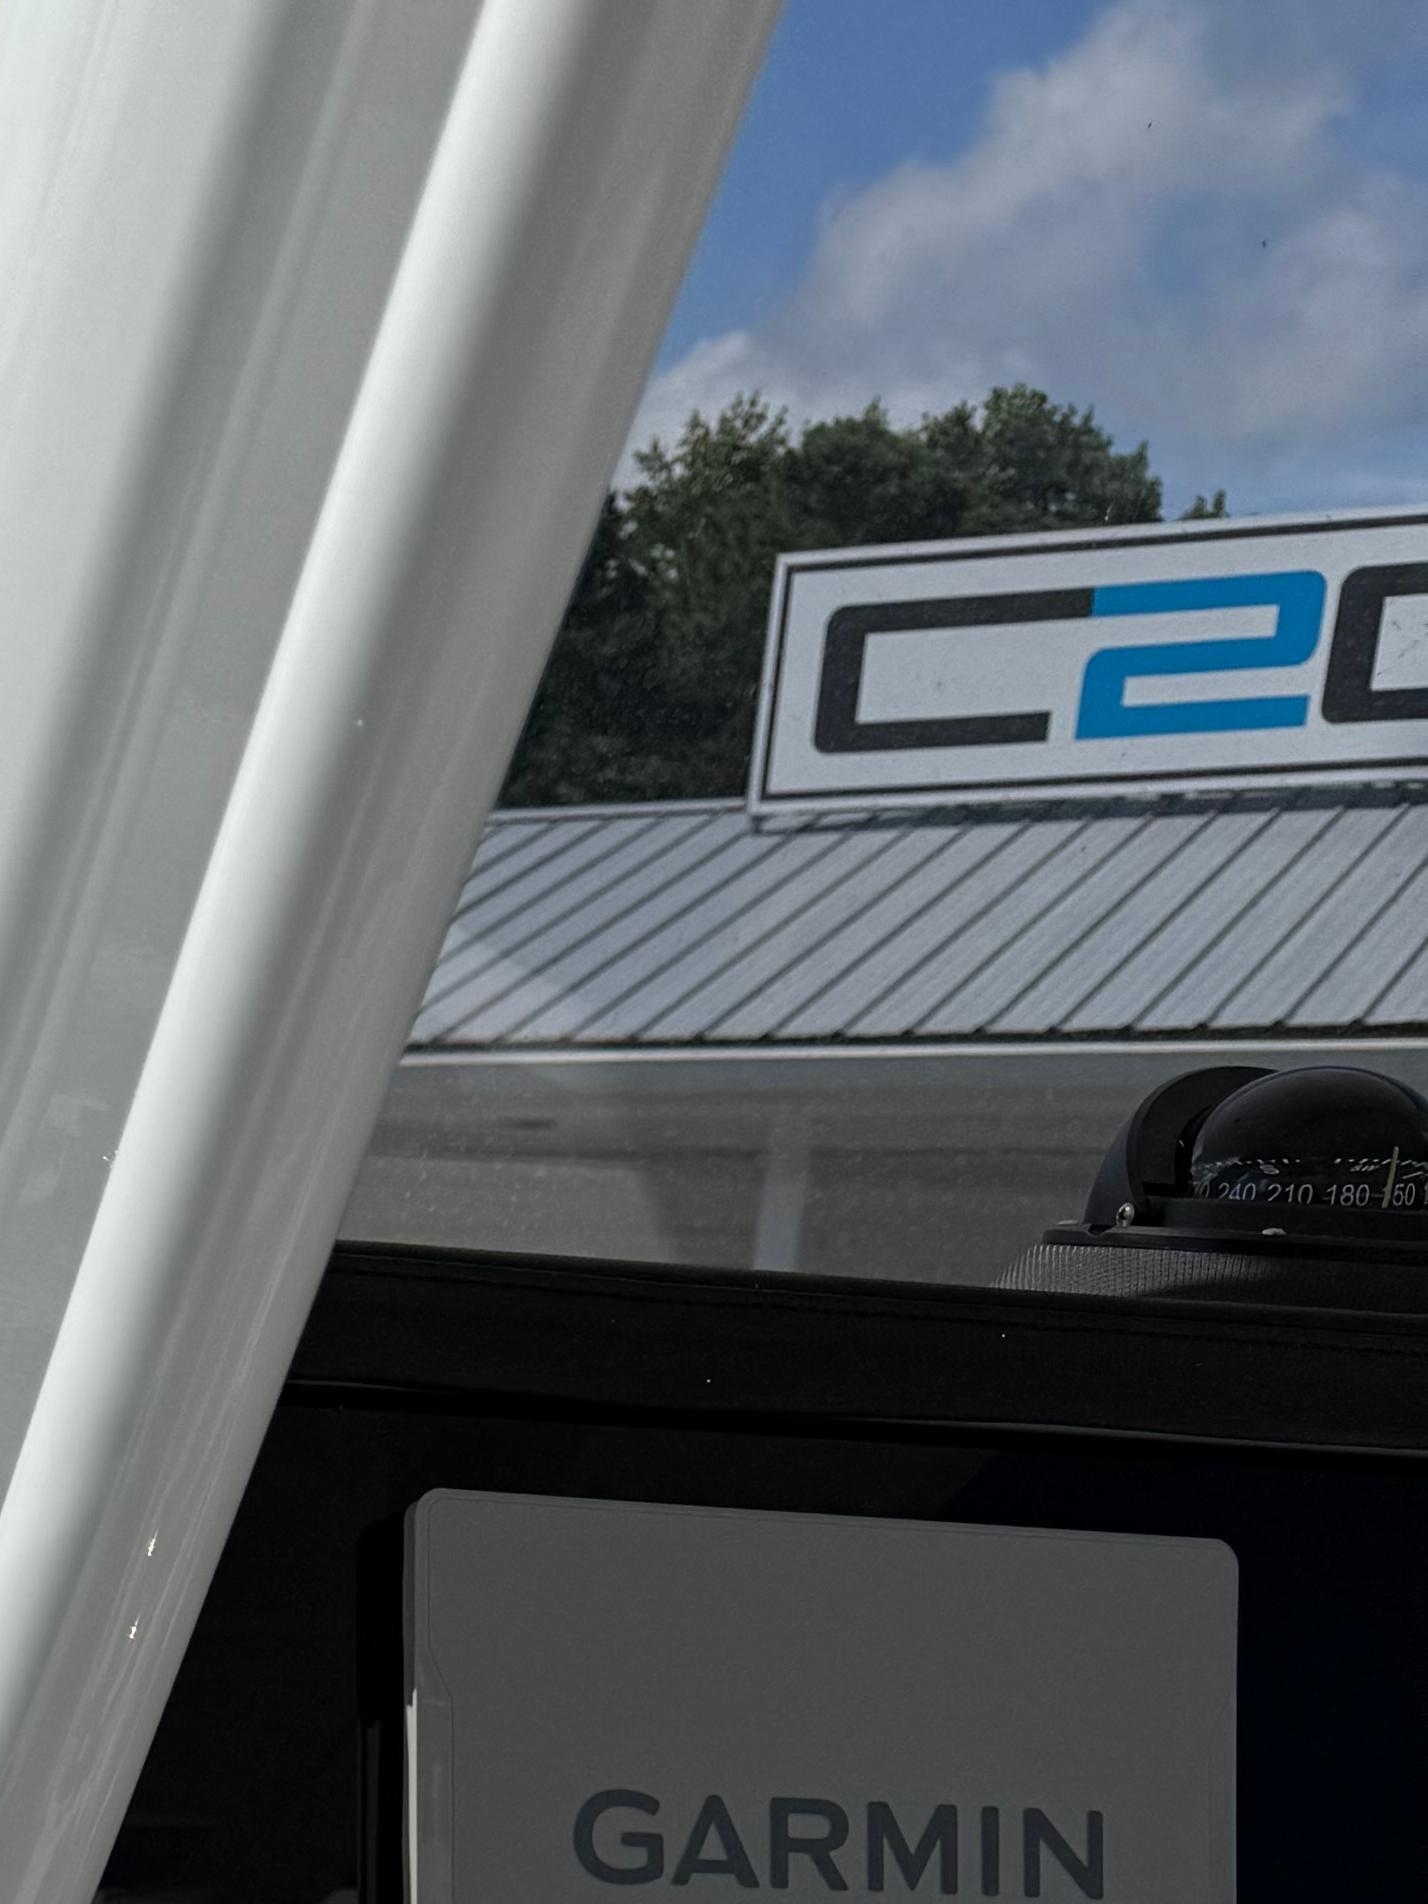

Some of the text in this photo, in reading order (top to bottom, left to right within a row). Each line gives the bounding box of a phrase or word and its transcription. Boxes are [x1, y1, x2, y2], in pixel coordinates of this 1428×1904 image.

[1217, 1182, 1256, 1200] 240
[1266, 1183, 1314, 1204] 210
[1326, 1183, 1370, 1207] 180
[1384, 1182, 1416, 1206] 50
[572, 1787, 1104, 1900] GARMIN
